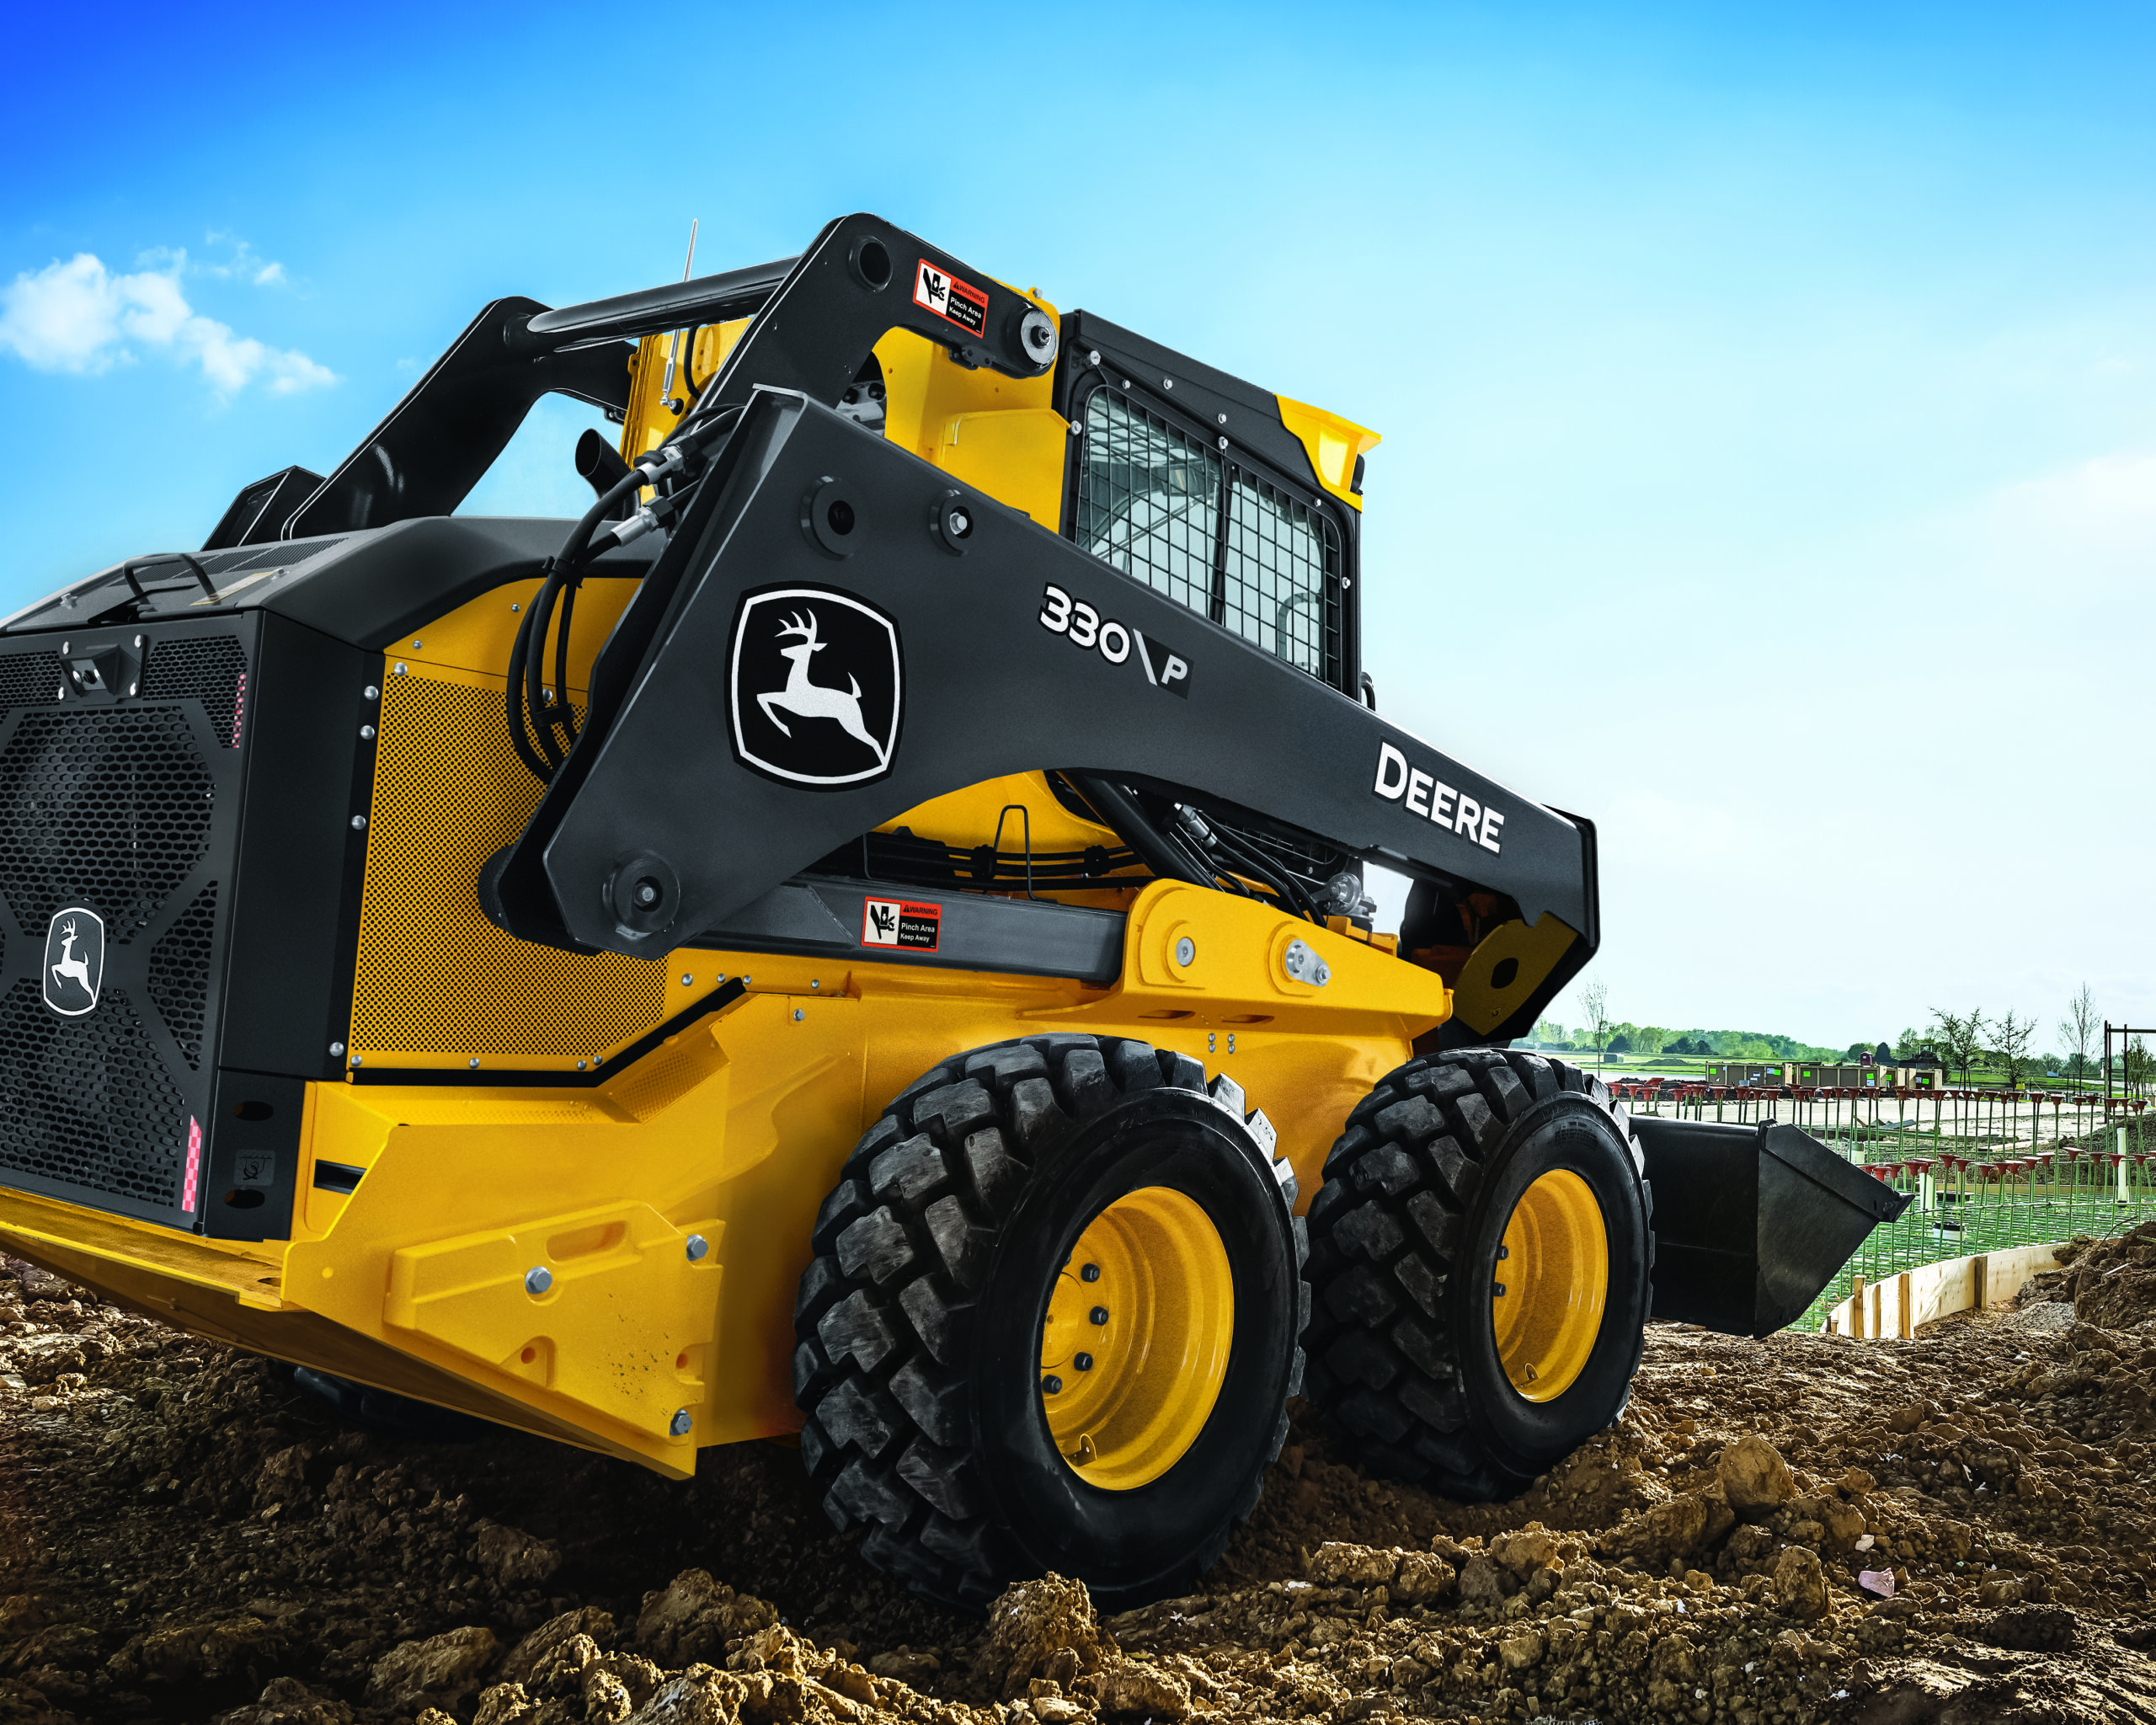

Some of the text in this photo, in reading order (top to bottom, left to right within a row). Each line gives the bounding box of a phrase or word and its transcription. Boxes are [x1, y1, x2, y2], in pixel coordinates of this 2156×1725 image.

[958, 284, 985, 304] WARNING
[948, 306, 976, 326] Keep Away
[950, 296, 982, 318] Pinch Area
[1039, 585, 1131, 665] 330
[1374, 741, 1505, 854] DEERE
[910, 906, 938, 916] WARNING
[901, 922, 920, 932] Pinch
[900, 932, 930, 943] Keep Away
